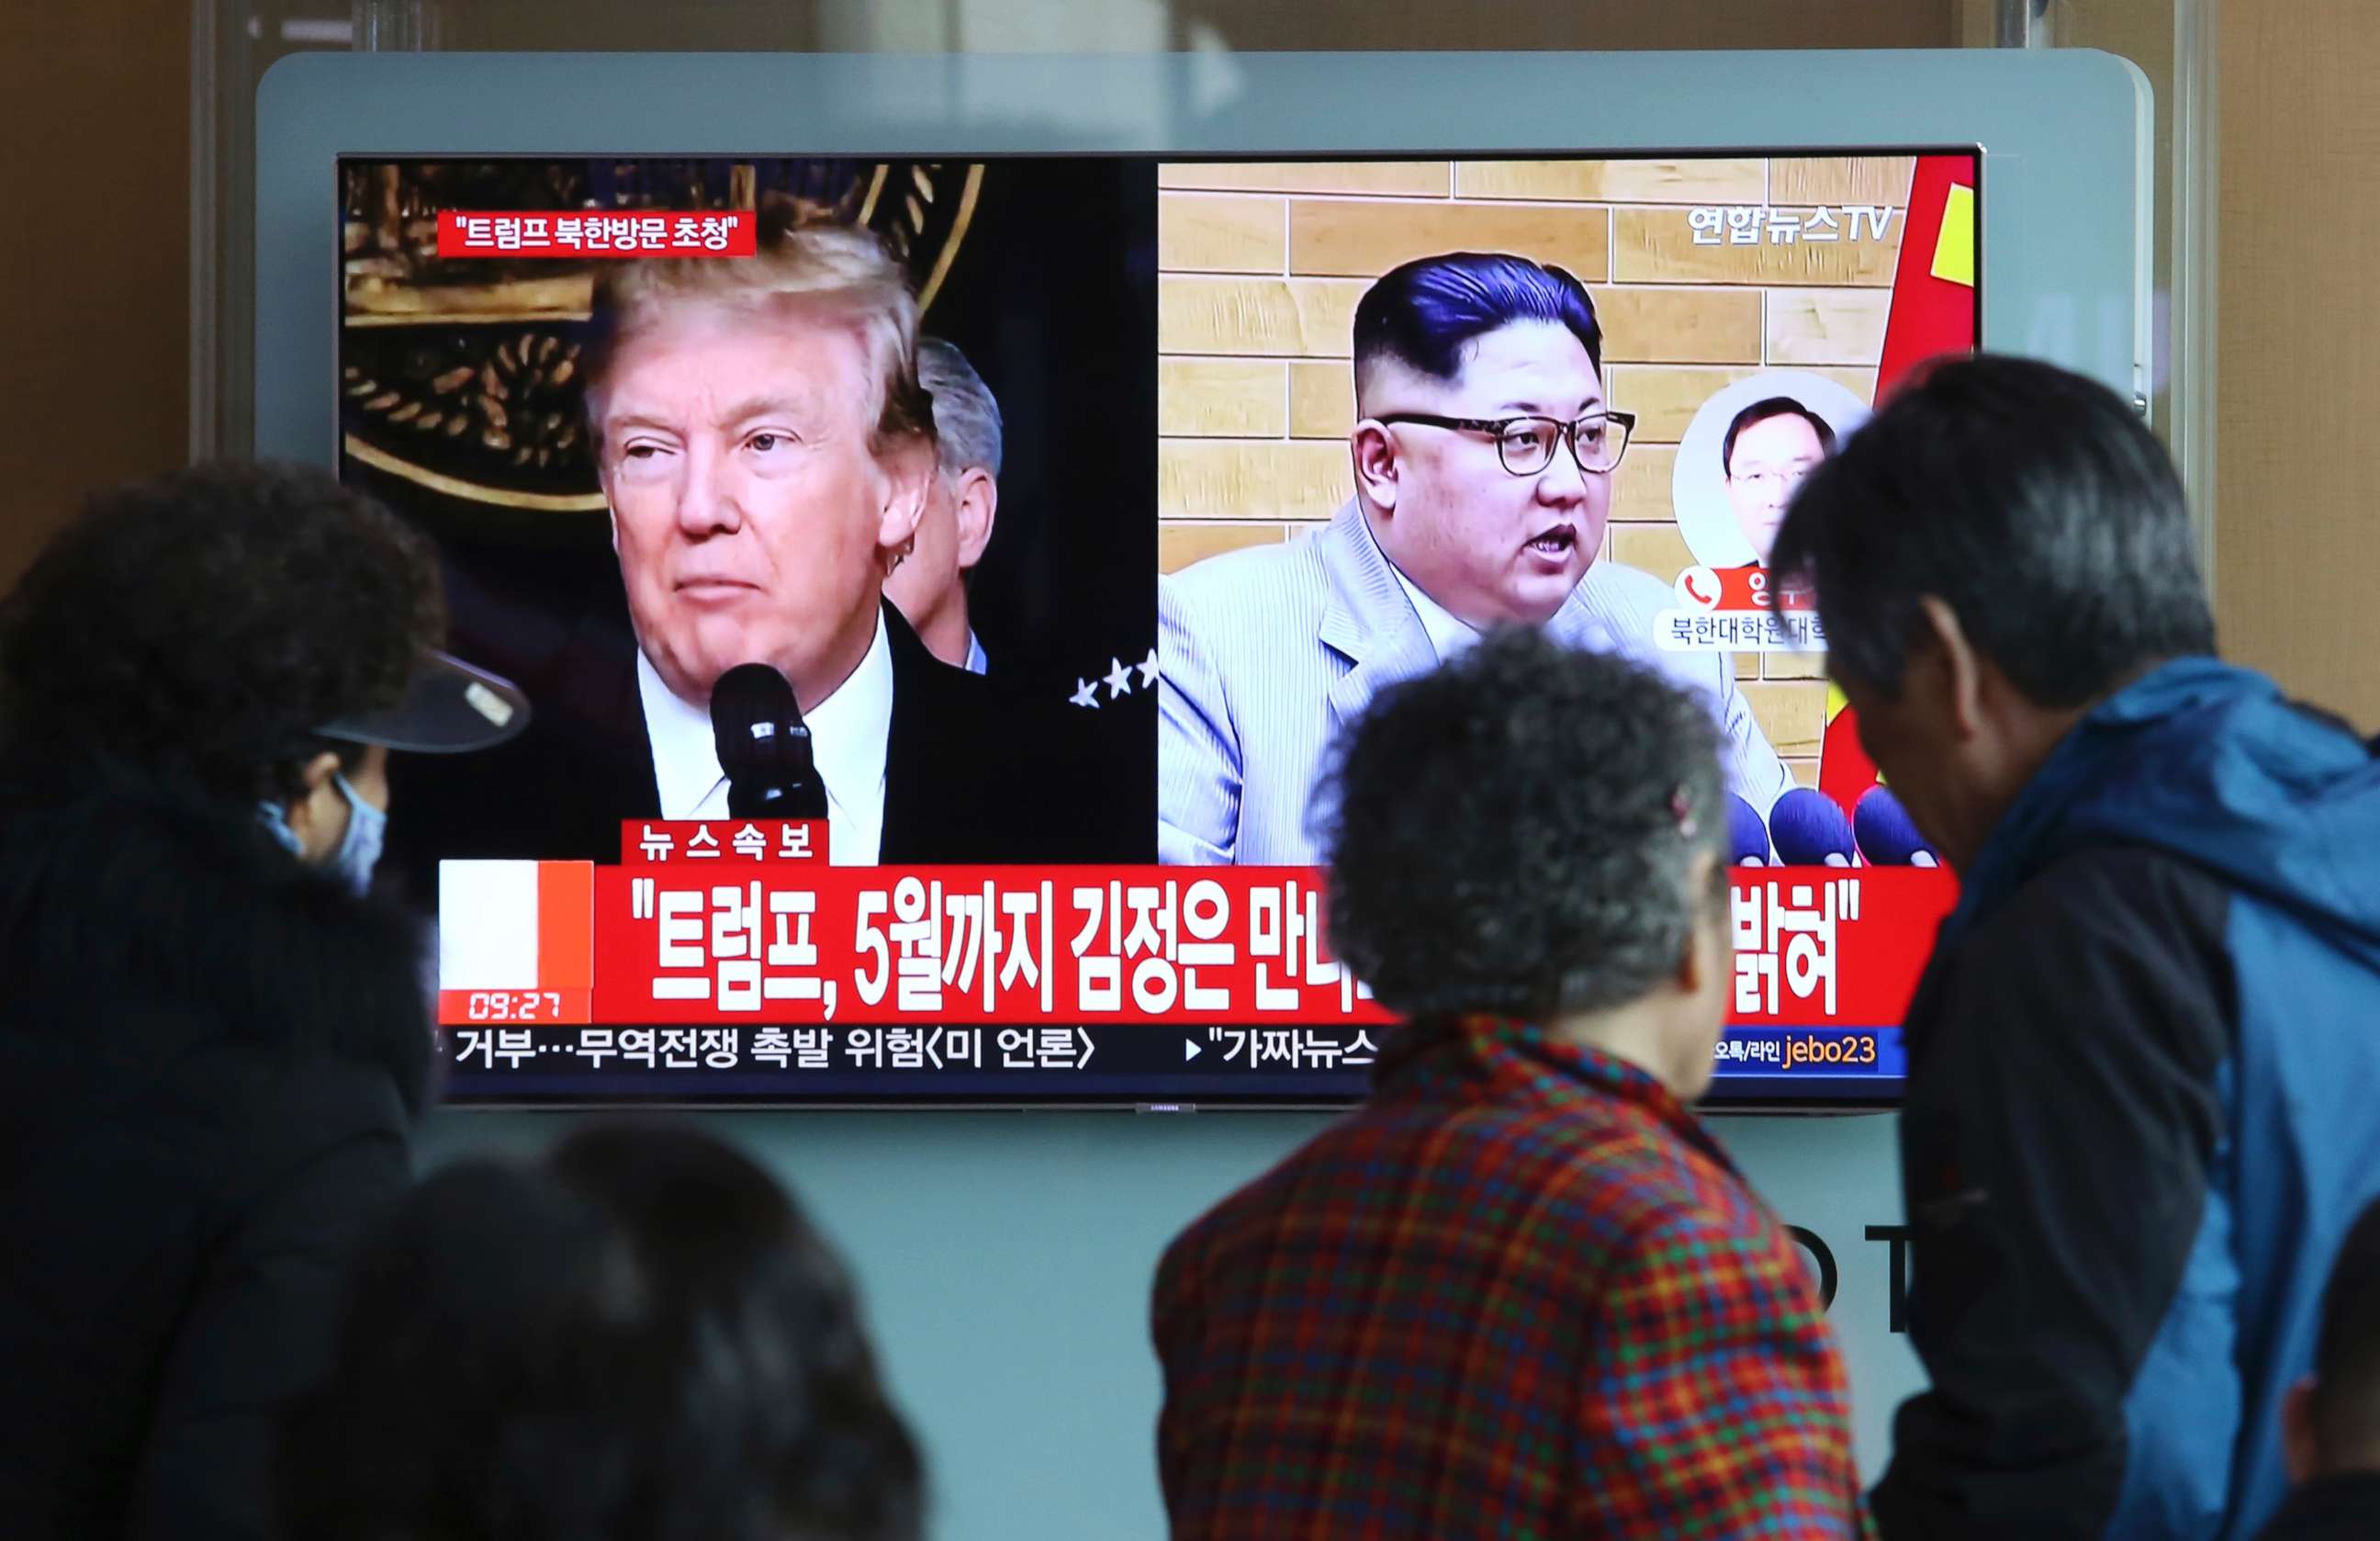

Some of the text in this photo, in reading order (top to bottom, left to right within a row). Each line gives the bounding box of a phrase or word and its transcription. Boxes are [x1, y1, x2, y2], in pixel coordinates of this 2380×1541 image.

[455, 216, 738, 251] "트럼프 북한방문 초청"
[1688, 206, 1892, 244] 연합뉴스TV
[632, 878, 837, 1021] "트럼프,
[854, 876, 1053, 1012] 5월까지
[1071, 879, 1235, 1014] 김정은
[1730, 878, 1860, 1015] 밝혀"
[468, 992, 560, 1019] 09:27
[750, 1027, 834, 1069] 촉발
[1781, 1034, 1876, 1070] jebo23
